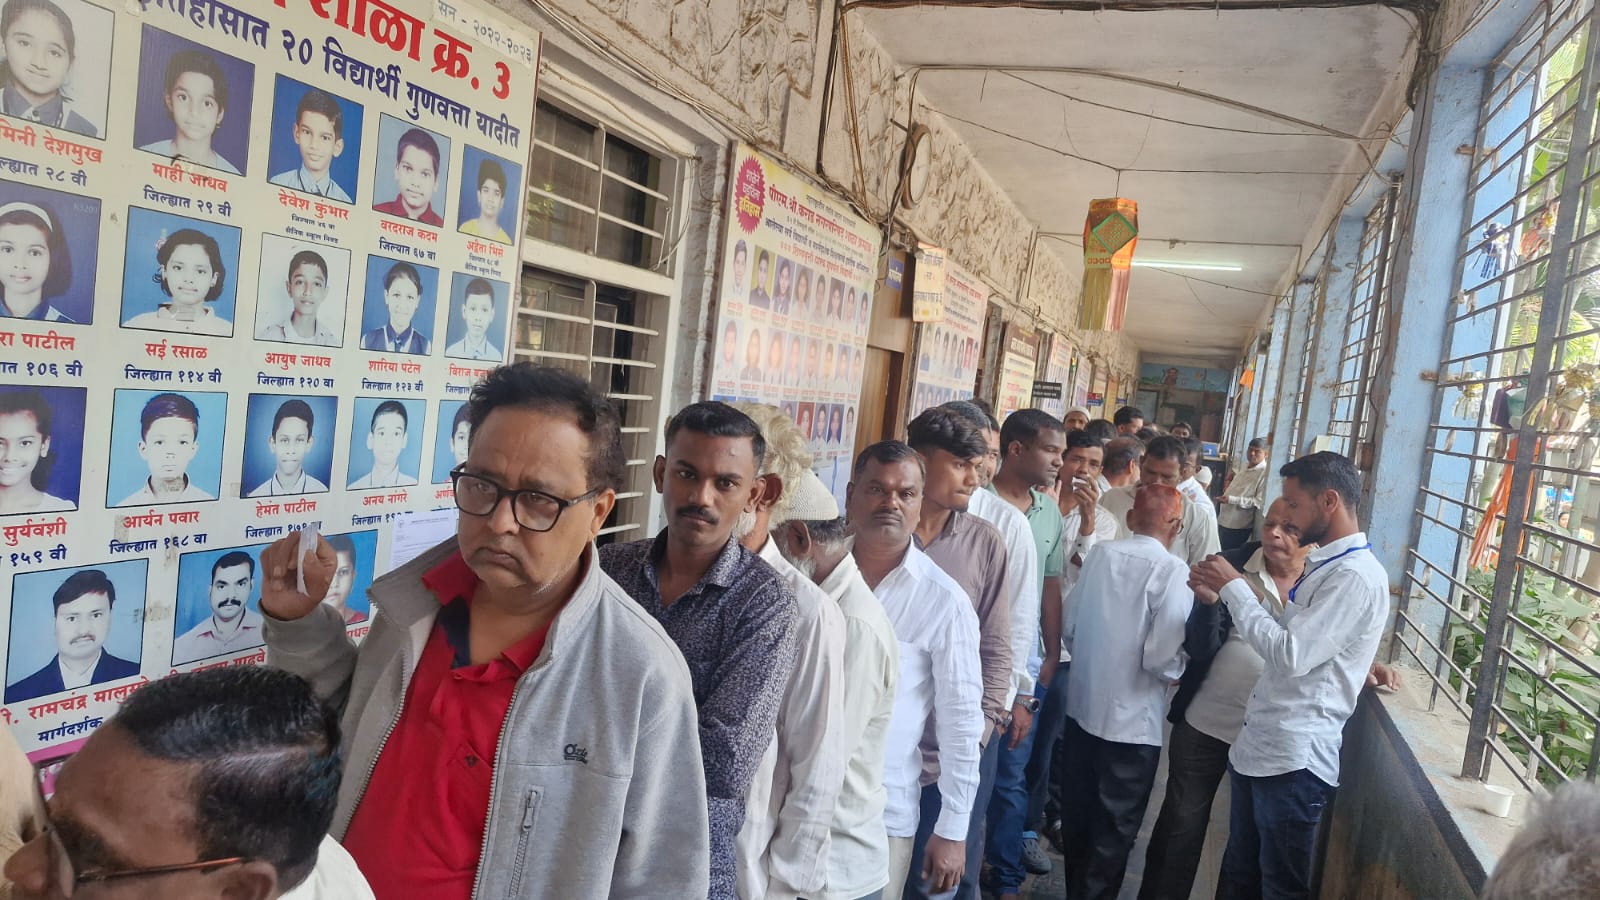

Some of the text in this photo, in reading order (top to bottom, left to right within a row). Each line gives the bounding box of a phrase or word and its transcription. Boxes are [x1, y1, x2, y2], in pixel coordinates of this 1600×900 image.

[431, 28, 480, 90] क्र.
[281, 29, 313, 65] २०
[322, 36, 401, 101] विद्यार्थी
[406, 81, 471, 129] गुणवत्ता
[476, 111, 520, 149] यादीत
[43, 129, 103, 166] देशमुख
[46, 166, 65, 181] २८
[70, 169, 88, 187] वी
[152, 162, 228, 193] माही जाधव
[143, 184, 232, 217] जिल्ह्यात २९ वी
[278, 188, 349, 220] देवेश कुंभार
[380, 219, 438, 242] वरदराज कदम
[413, 247, 425, 259] ६७
[427, 250, 436, 260] वा
[21, 329, 76, 351] पाटील
[144, 339, 208, 360] सई रसाळ
[27, 362, 59, 377] १०६
[65, 360, 83, 377] वी
[265, 352, 332, 370] आयुष जाधव
[401, 359, 421, 373] पटेल
[124, 364, 222, 383] जिल्ह्यात ११४ वी
[299, 377, 320, 388] १२०
[323, 378, 334, 388] वा
[395, 382, 412, 392] १२३
[414, 379, 423, 392] वी
[256, 498, 317, 518] हेमंत पाटील
[362, 495, 385, 506] अनय
[122, 509, 200, 528] आर्यन पवार
[109, 533, 207, 554] जिल्ह्यात १६८ वा
[10, 543, 67, 566] १५९ वी
[28, 692, 88, 719] रामचंद्र
[37, 716, 104, 742] मार्गदर्शक
